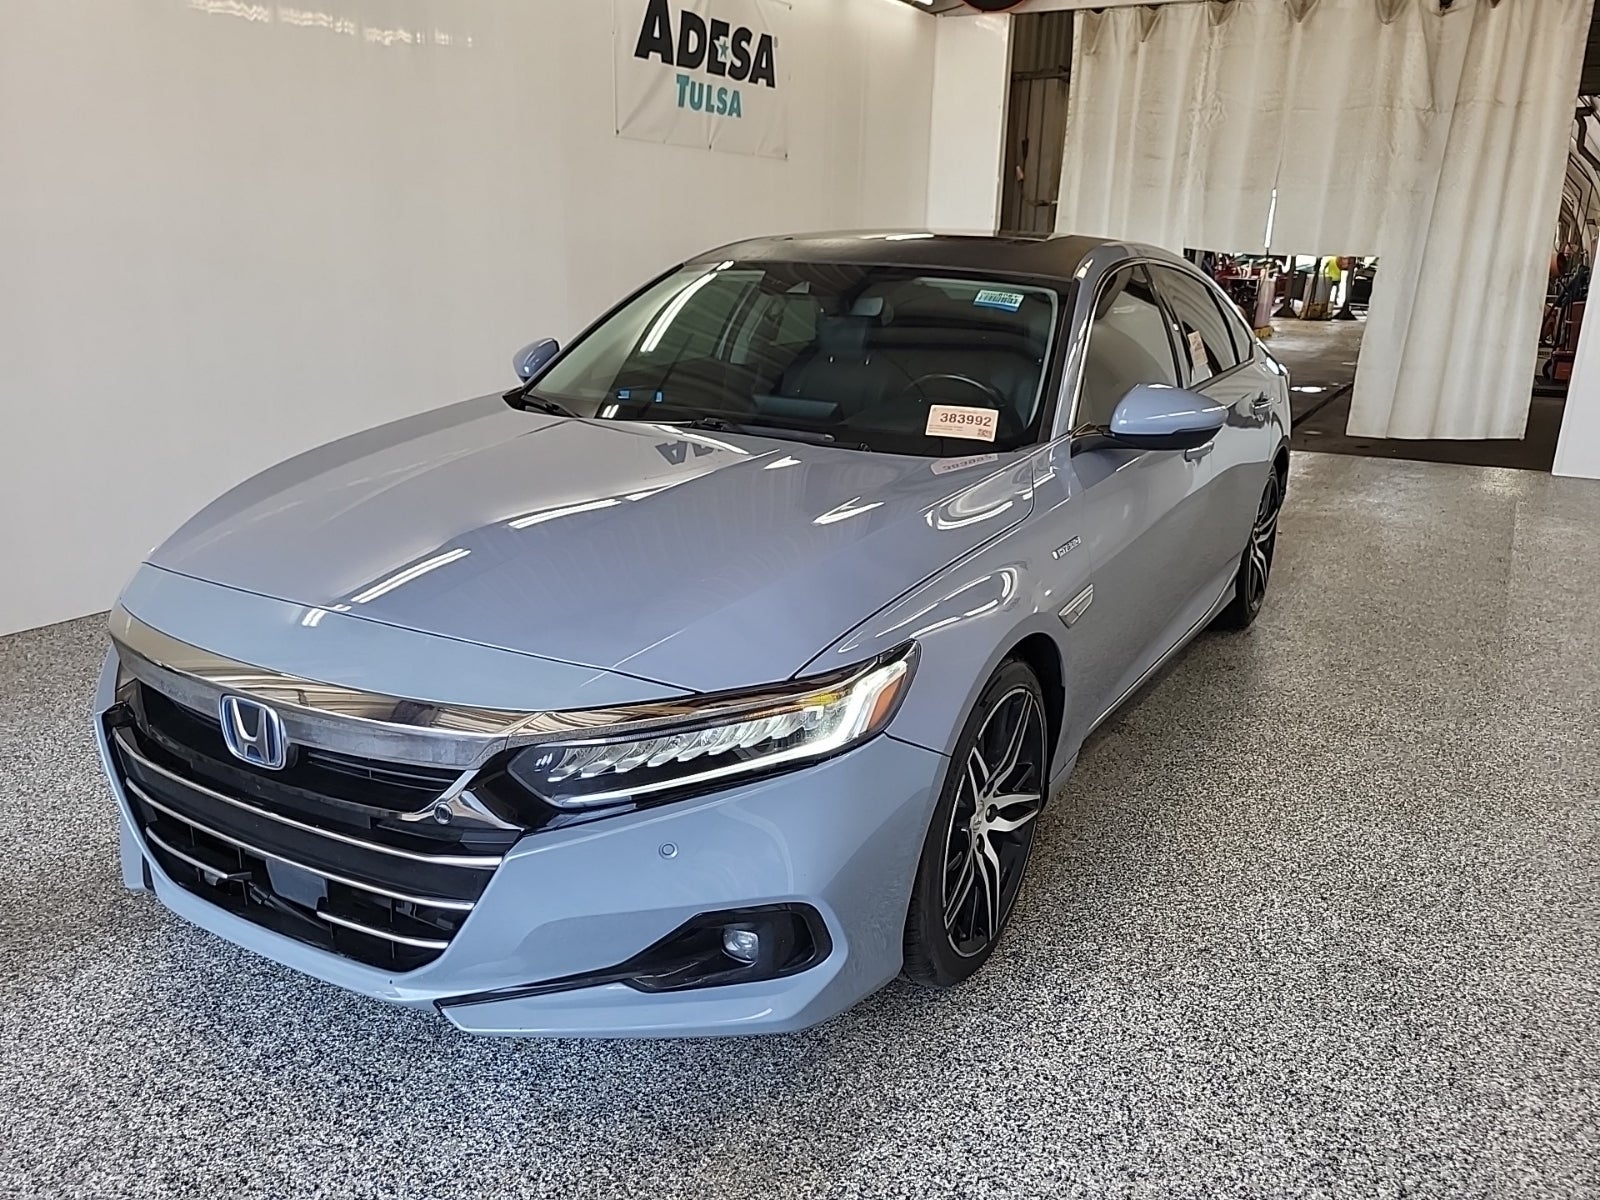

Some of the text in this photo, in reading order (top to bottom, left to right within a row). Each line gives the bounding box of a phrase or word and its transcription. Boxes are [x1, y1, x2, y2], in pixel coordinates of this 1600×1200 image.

[634, 0, 775, 88] ADESA
[676, 74, 742, 118] TULSA
[940, 413, 992, 427] 383992
